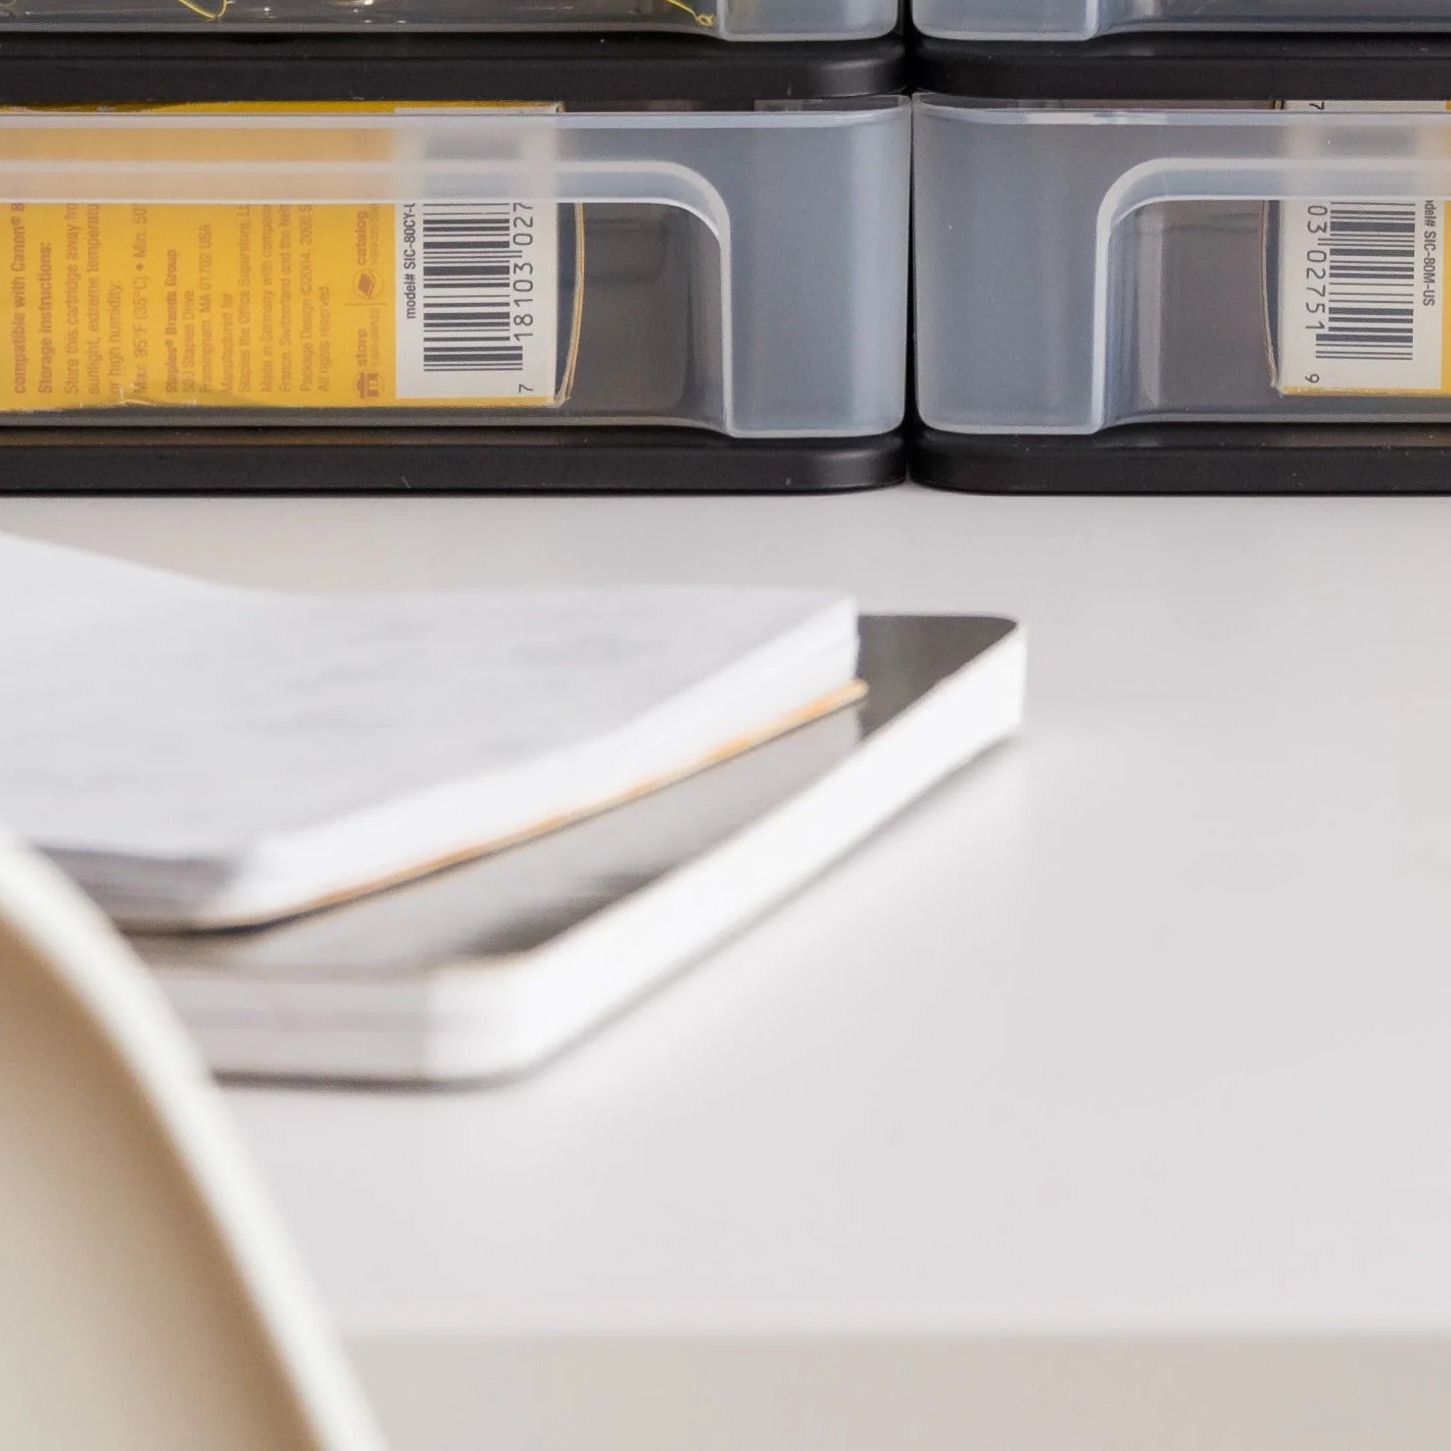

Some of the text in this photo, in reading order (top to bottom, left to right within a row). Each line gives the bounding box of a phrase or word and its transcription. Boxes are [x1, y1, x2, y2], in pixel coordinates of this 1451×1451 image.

[198, 224, 211, 248] USA
[279, 230, 290, 249] the
[354, 211, 369, 266] catalog
[165, 250, 179, 286] Group
[199, 253, 211, 290] 01702
[261, 261, 272, 285] with
[279, 253, 291, 274] and
[404, 203, 416, 319] model# SIC-80CY-
[1423, 231, 1436, 306] SIC-80M-US
[11, 277, 25, 308] with
[64, 203, 82, 394] Store this cartridge away fro
[87, 203, 102, 394] sunlight, extreme temperatu
[183, 290, 195, 319] Drive
[200, 294, 211, 313] MA
[513, 203, 533, 393] 7 18103 027
[1306, 250, 1327, 329] 02751
[37, 242, 55, 394] Storage instructions:
[165, 291, 177, 335] Brands
[260, 291, 274, 342] Germany
[300, 299, 315, 339] Design
[11, 313, 27, 394] compatible
[182, 324, 196, 367] Staples
[238, 328, 250, 346] the
[261, 347, 272, 356] in
[355, 329, 367, 367] store
[107, 347, 123, 376] high
[238, 350, 252, 393] Staples
[299, 343, 315, 392] Package
[318, 341, 332, 373] rights
[261, 361, 272, 393] Made
[318, 377, 329, 392] All
[1305, 374, 1319, 384] 9
